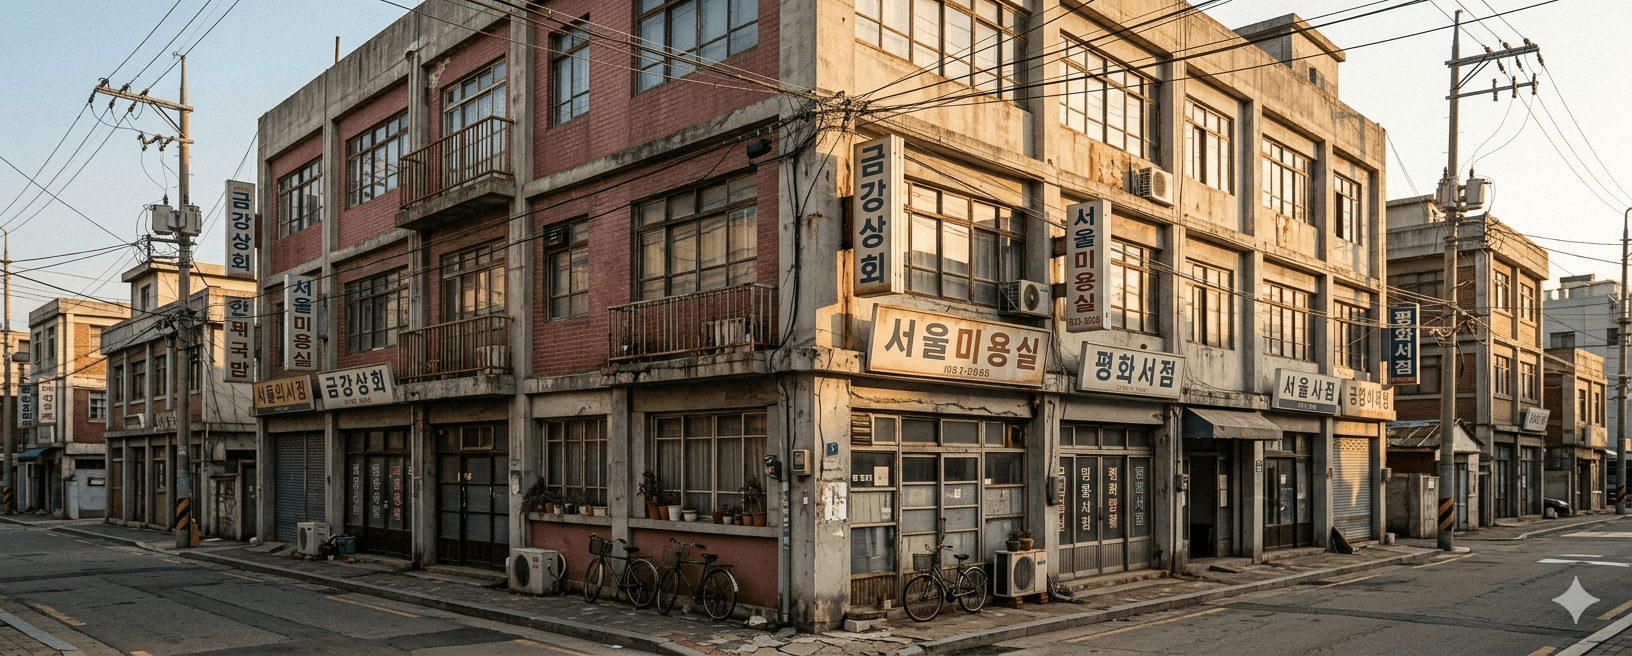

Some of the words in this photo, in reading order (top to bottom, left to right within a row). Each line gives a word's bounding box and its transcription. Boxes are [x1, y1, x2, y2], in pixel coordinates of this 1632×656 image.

[231, 191, 252, 272] 금강상회
[858, 143, 887, 285] 금강상회
[1073, 206, 1096, 314] 서울미용실
[293, 280, 312, 368] 서울미용실
[884, 318, 1040, 371] 서울미용실
[1394, 310, 1414, 375] 평화서점
[325, 369, 387, 399] 금강상회
[1095, 350, 1176, 389] 평화서점
